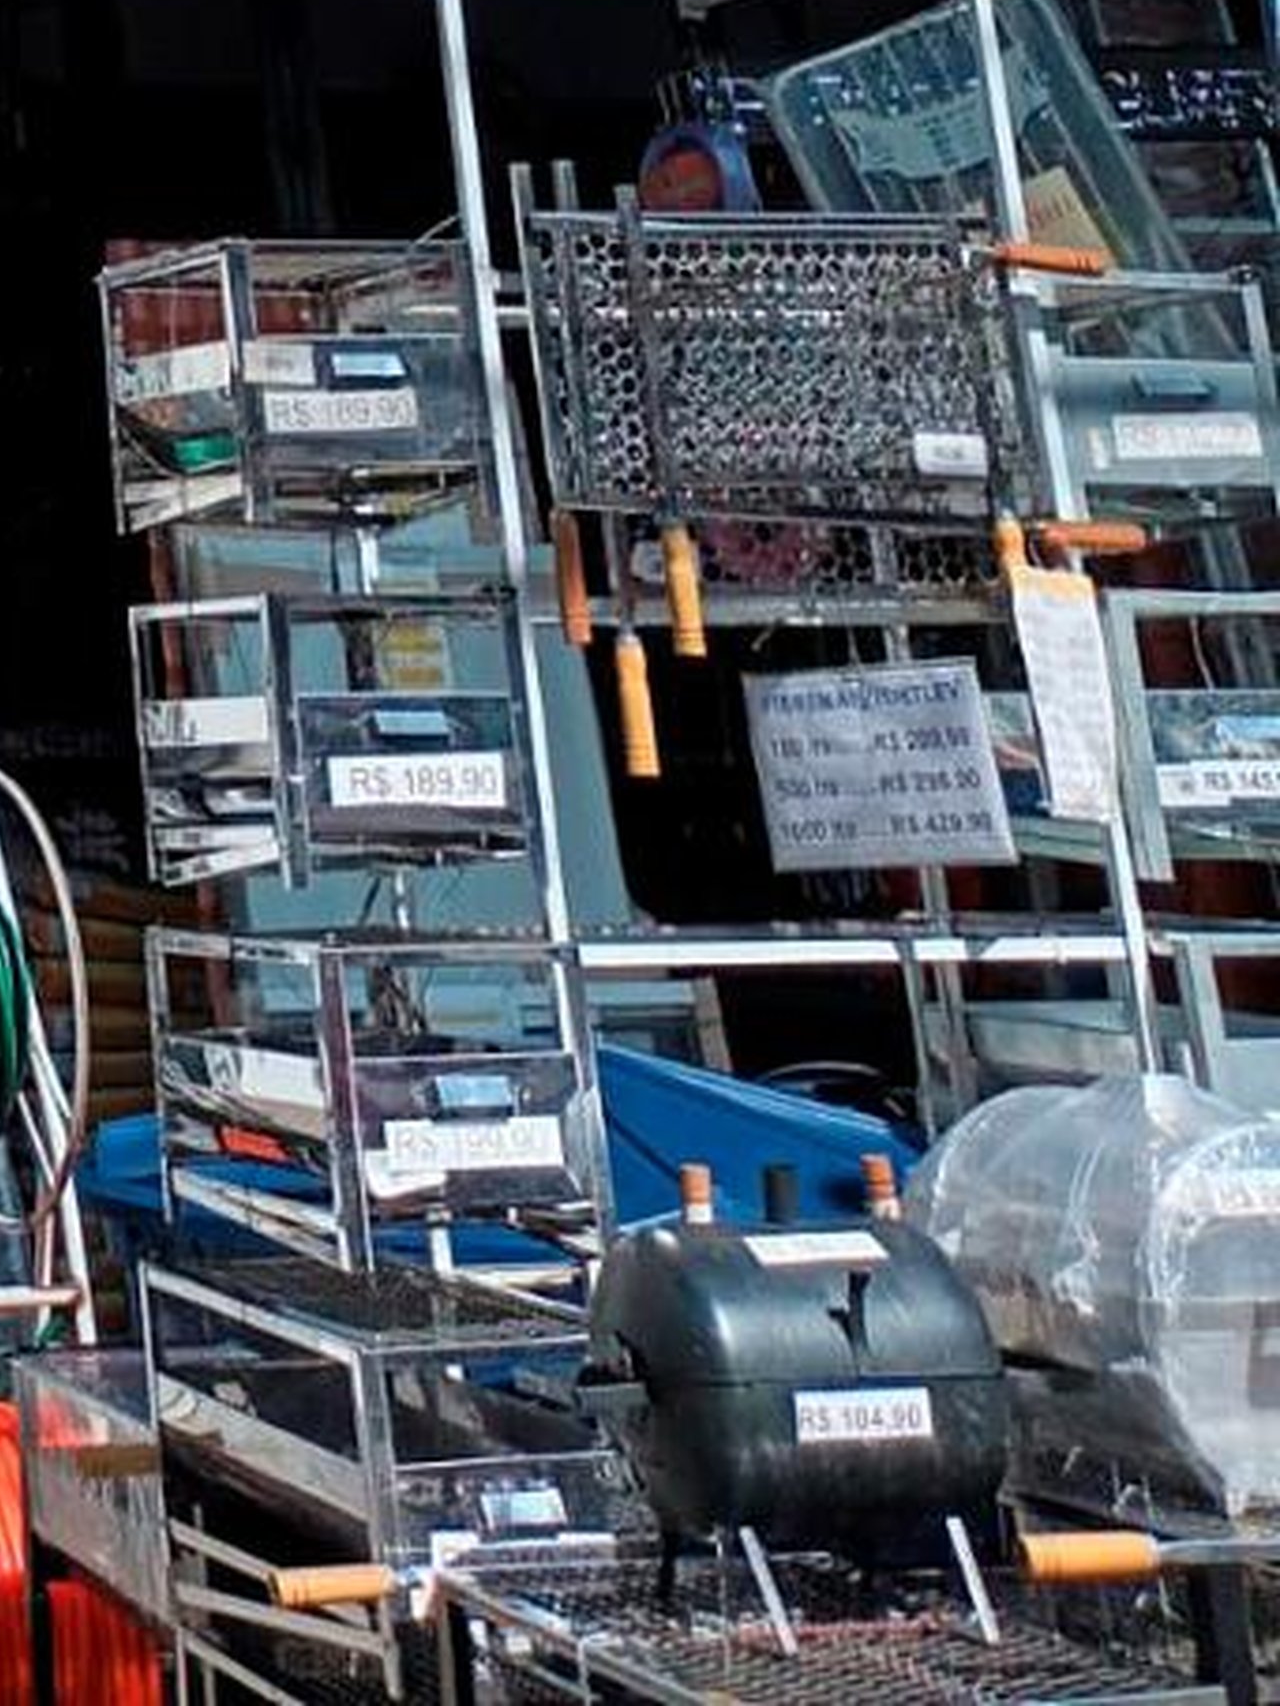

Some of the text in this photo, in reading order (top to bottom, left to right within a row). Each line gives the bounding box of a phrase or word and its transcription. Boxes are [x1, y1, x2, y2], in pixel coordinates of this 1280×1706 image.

[349, 764, 502, 796] R$ 189,90
[798, 1405, 832, 1433] R$
